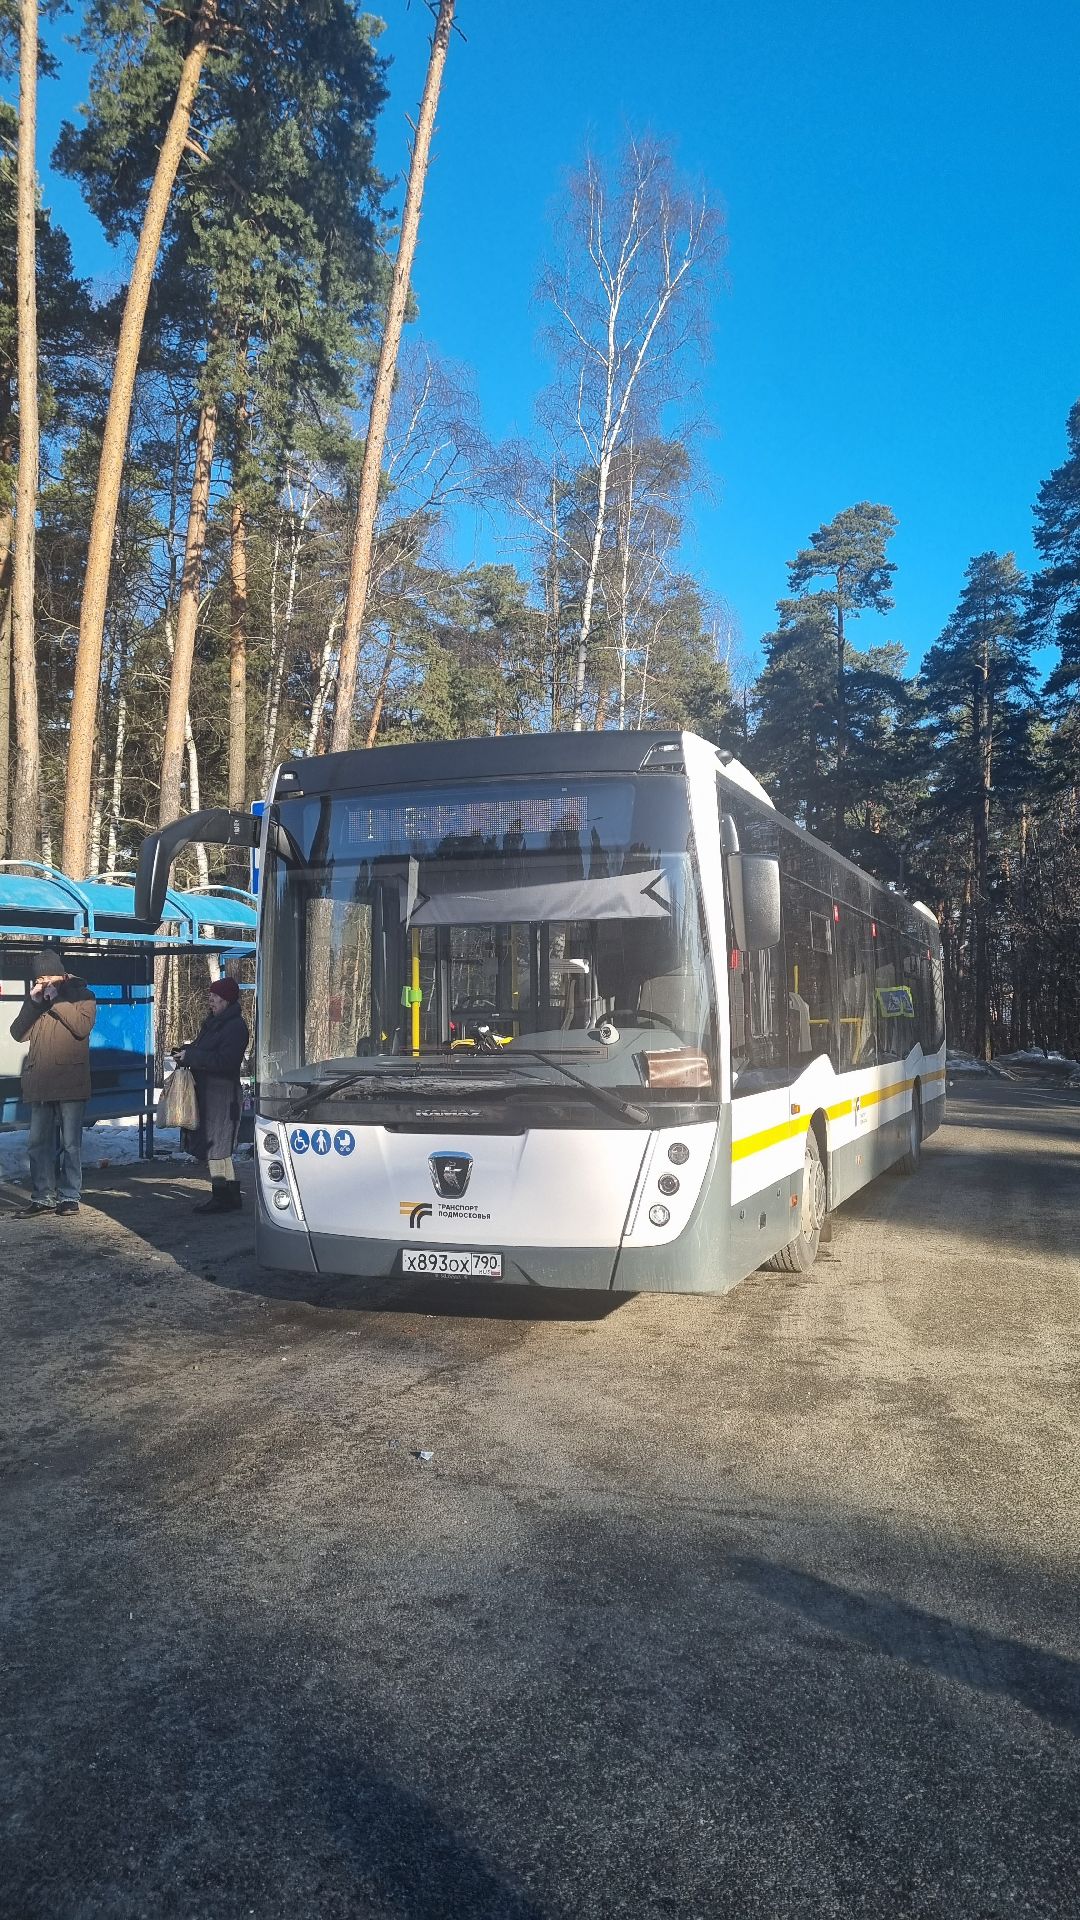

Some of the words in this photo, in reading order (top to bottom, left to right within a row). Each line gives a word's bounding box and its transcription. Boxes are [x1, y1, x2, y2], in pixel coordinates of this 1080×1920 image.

[438, 1204, 478, 1212] ТРАНСПОРТ
[438, 1211, 490, 1219] ПОДМОСКОВЬЯ
[473, 1255, 497, 1270] 790
